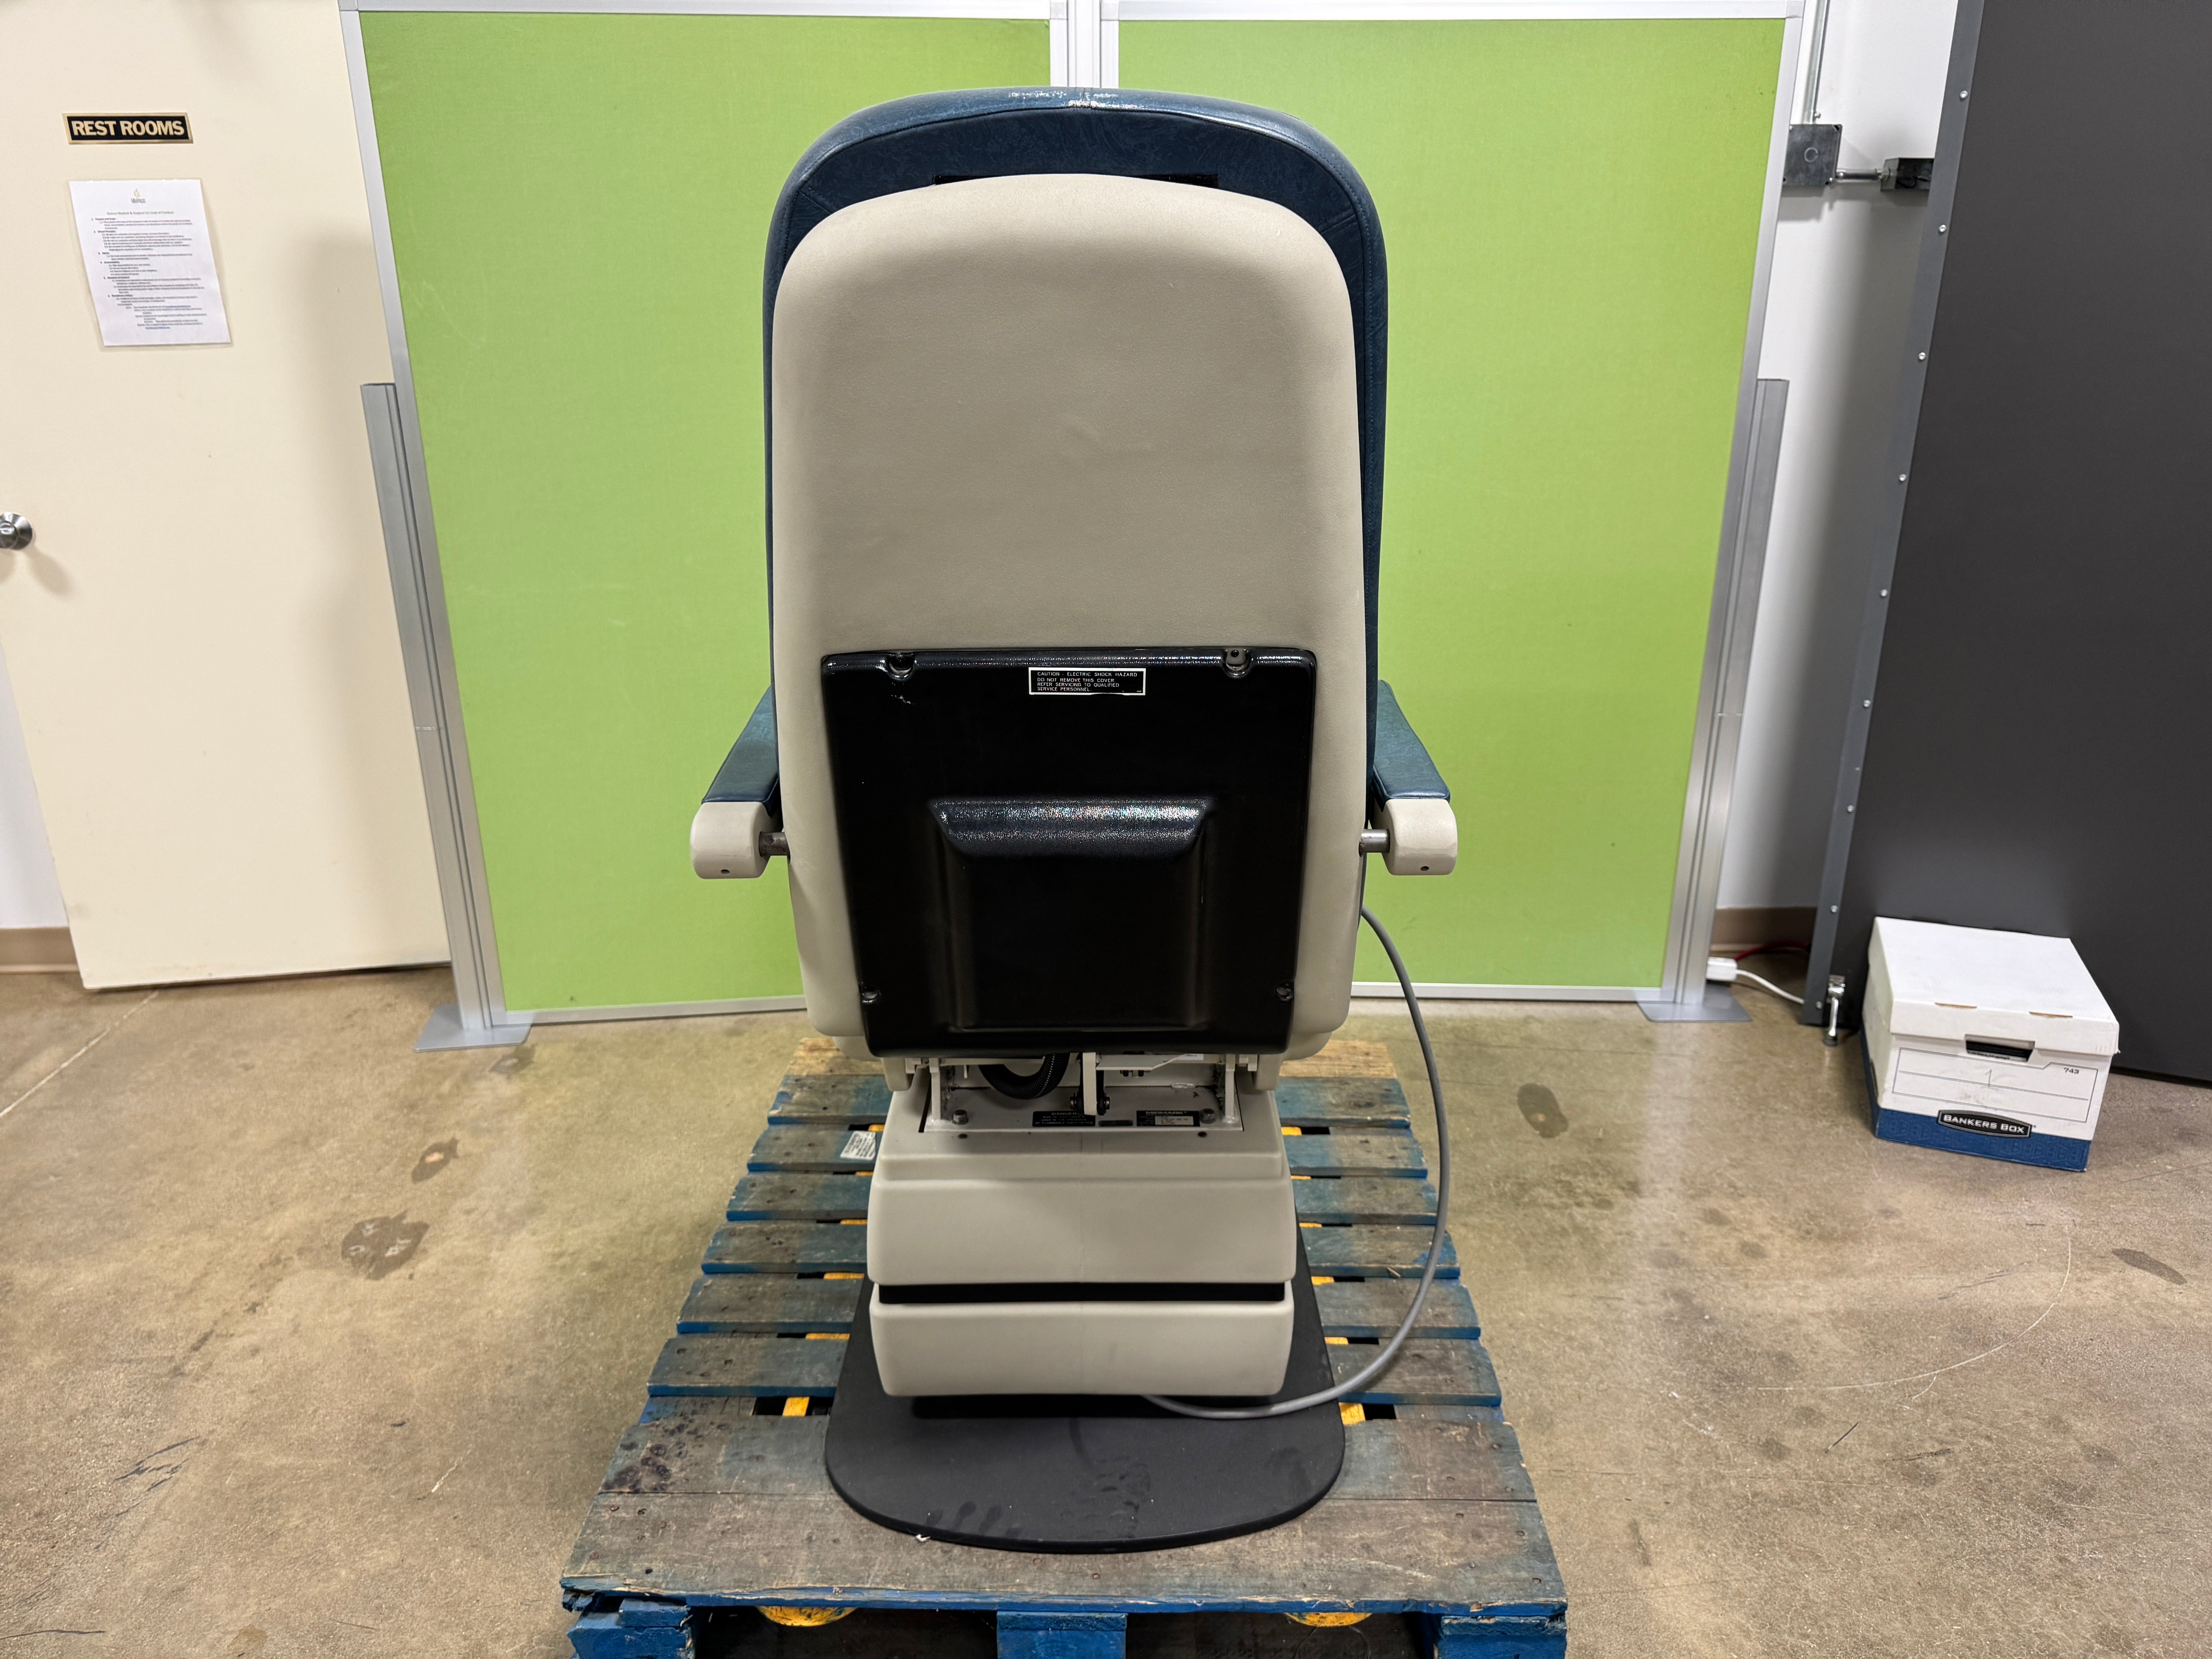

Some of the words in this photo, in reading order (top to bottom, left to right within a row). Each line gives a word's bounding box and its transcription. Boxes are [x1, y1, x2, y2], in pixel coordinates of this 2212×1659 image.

[71, 120, 117, 136] REST
[119, 120, 185, 136] ROOMS
[1943, 1114, 1997, 1130] BANKERS
[2000, 1123, 2025, 1134] BOX
